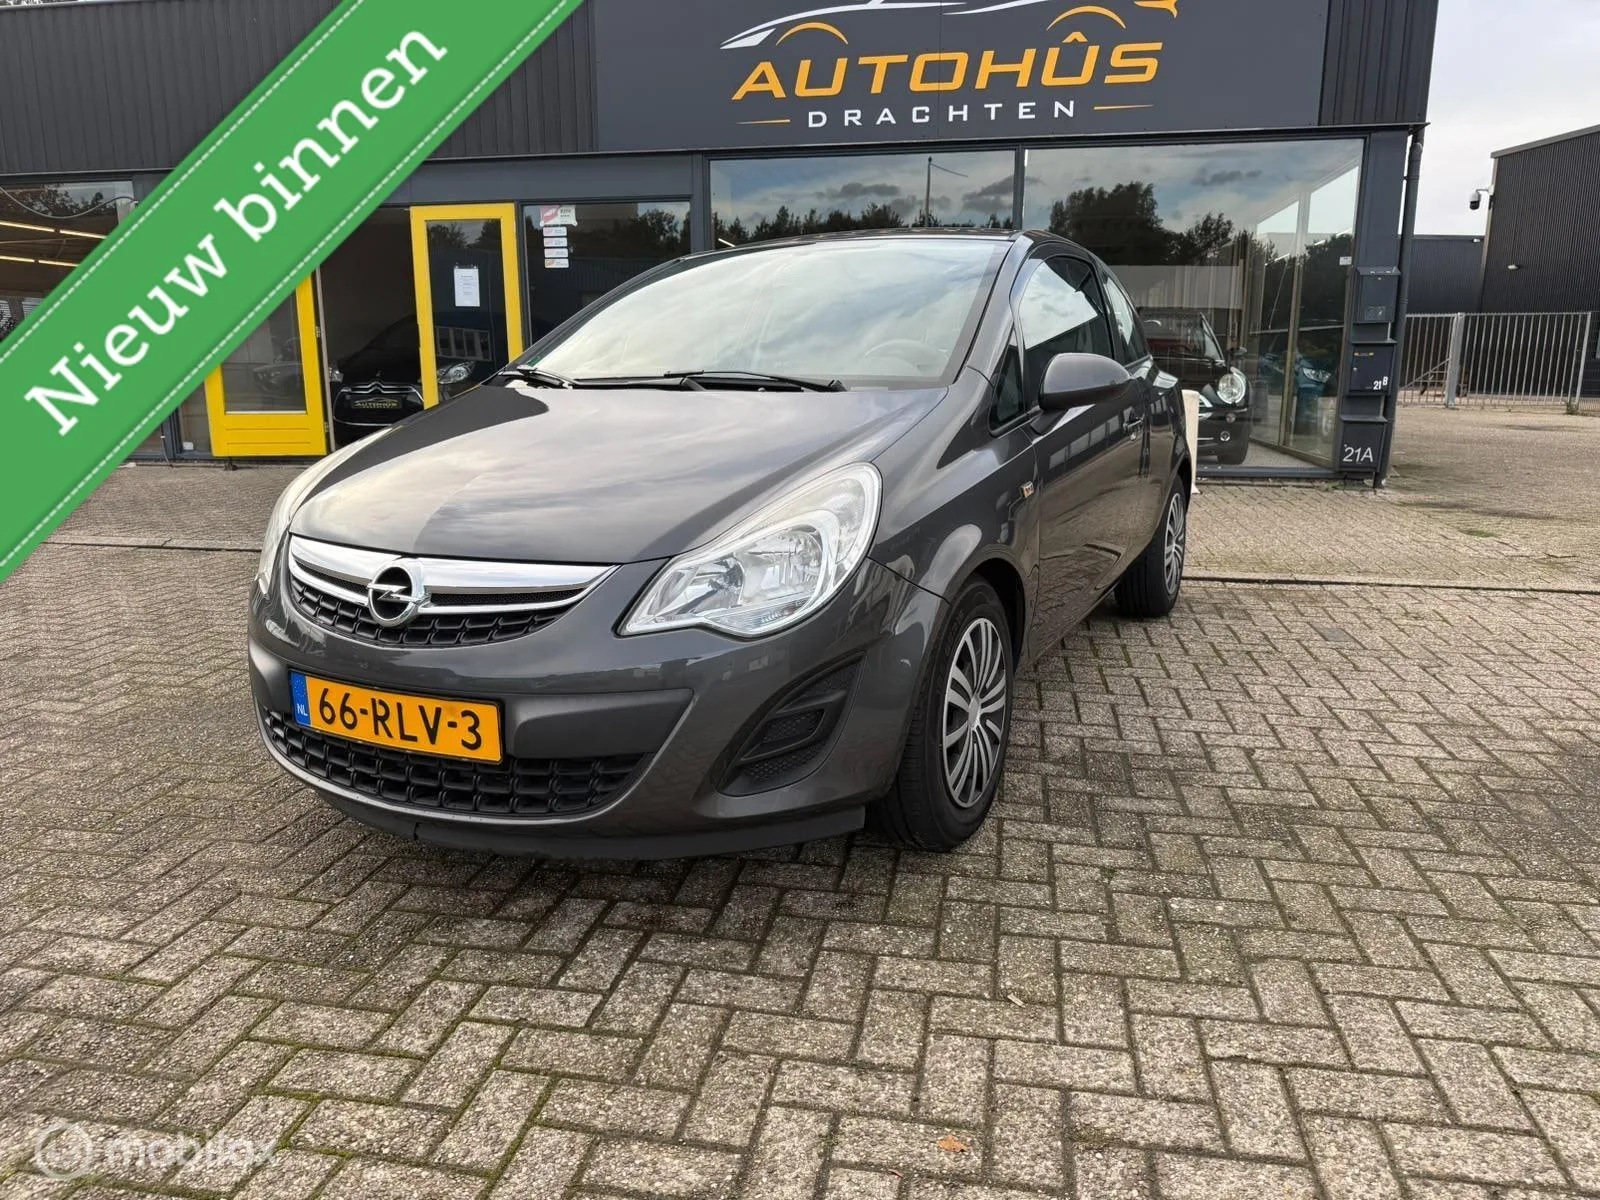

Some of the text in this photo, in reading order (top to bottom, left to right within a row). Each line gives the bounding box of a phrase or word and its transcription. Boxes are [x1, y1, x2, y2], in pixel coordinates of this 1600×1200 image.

[732, 31, 1164, 101] AUTOHÛS
[807, 100, 1075, 129] DRACHTEN
[1342, 446, 1374, 463] 21A
[296, 703, 309, 717] NL
[319, 687, 482, 751] 66-RLV-3
